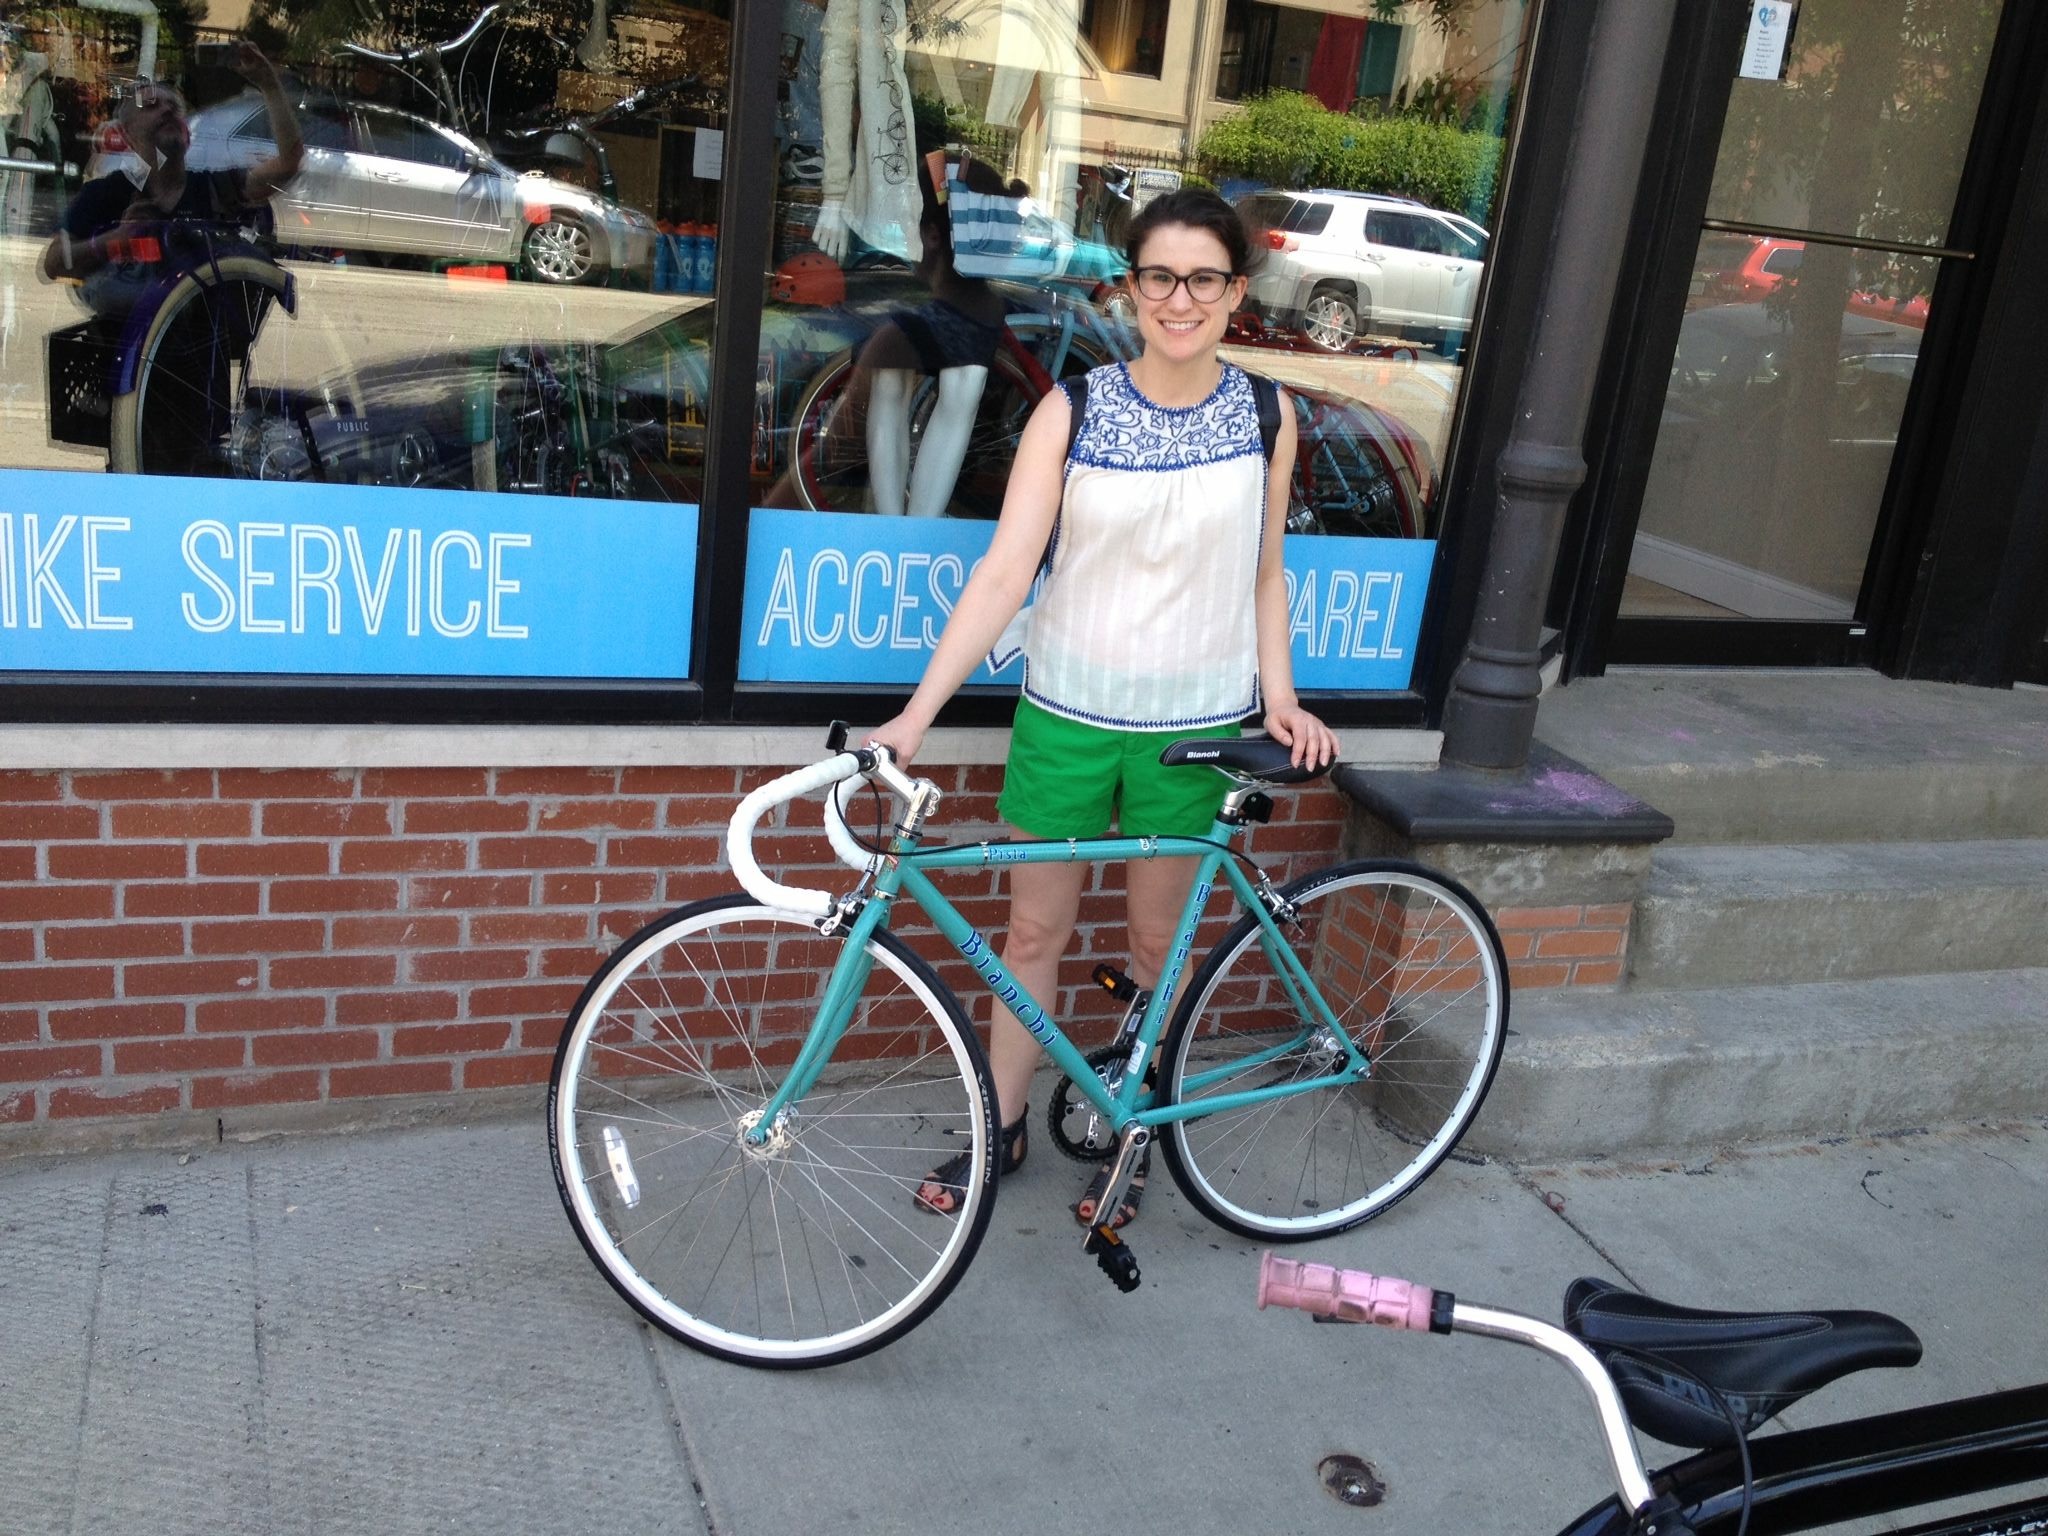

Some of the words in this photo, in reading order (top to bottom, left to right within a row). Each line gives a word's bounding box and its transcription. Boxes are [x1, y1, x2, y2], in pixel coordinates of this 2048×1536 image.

[337, 421, 369, 432] PUBLIC
[0, 512, 134, 630] IKE
[181, 519, 532, 639] SERVICE
[757, 547, 986, 649] ACCES
[1186, 750, 1220, 759] Bianchi
[989, 847, 1027, 860] Pista
[959, 929, 1060, 1046] Bianchi
[1155, 883, 1211, 1025] Bianchi
[977, 1071, 994, 1184] VREDESTEIN
